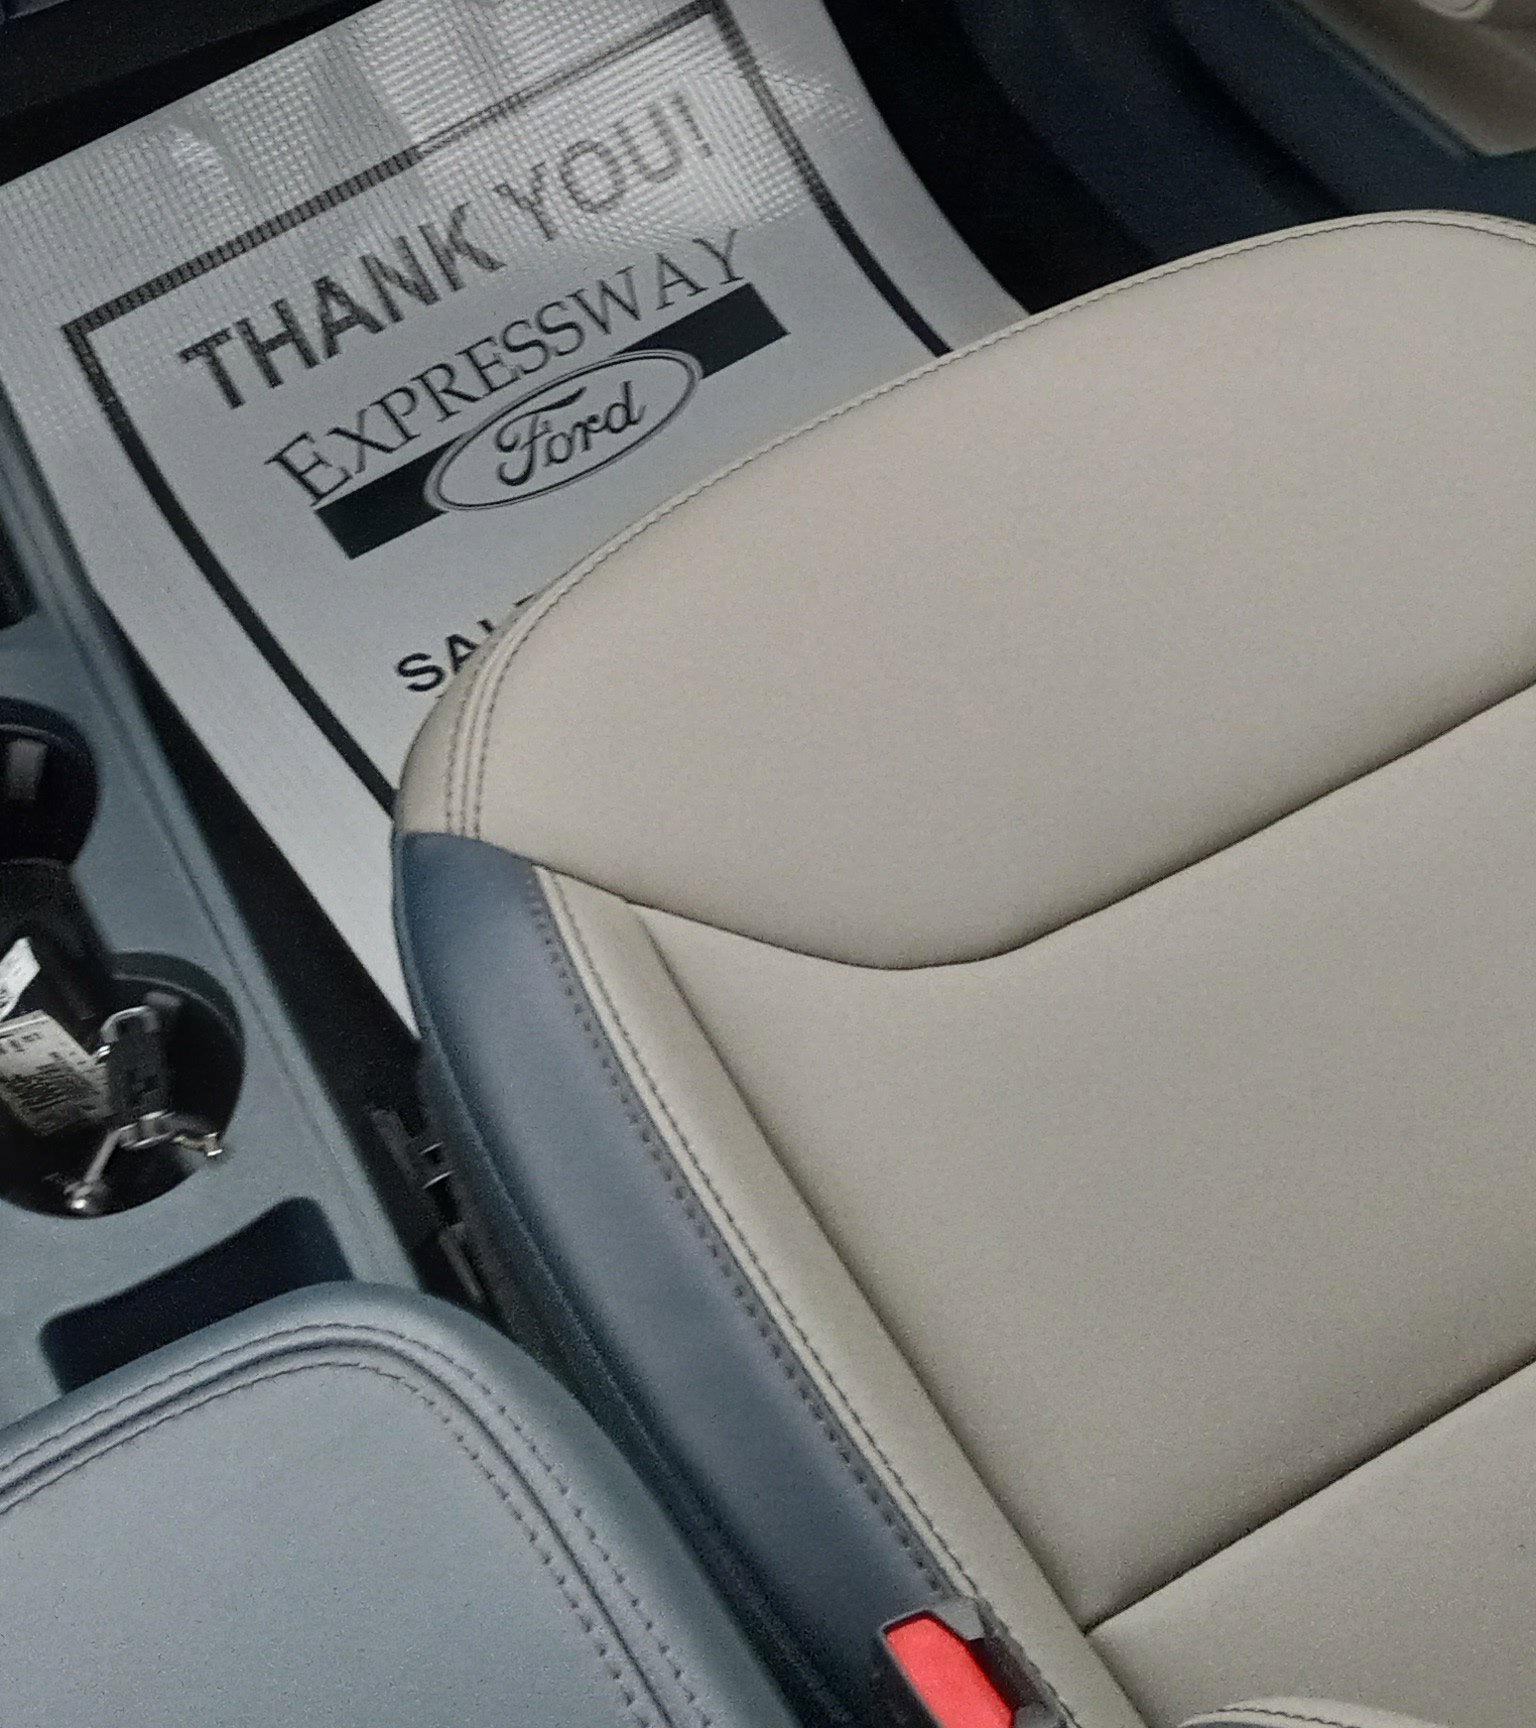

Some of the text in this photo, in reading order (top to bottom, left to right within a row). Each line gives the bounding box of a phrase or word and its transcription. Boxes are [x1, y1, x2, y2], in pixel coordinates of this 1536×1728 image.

[178, 89, 714, 410] THANK YOU!
[264, 226, 746, 507] EXPRESSWAY
[493, 380, 648, 488] Ford
